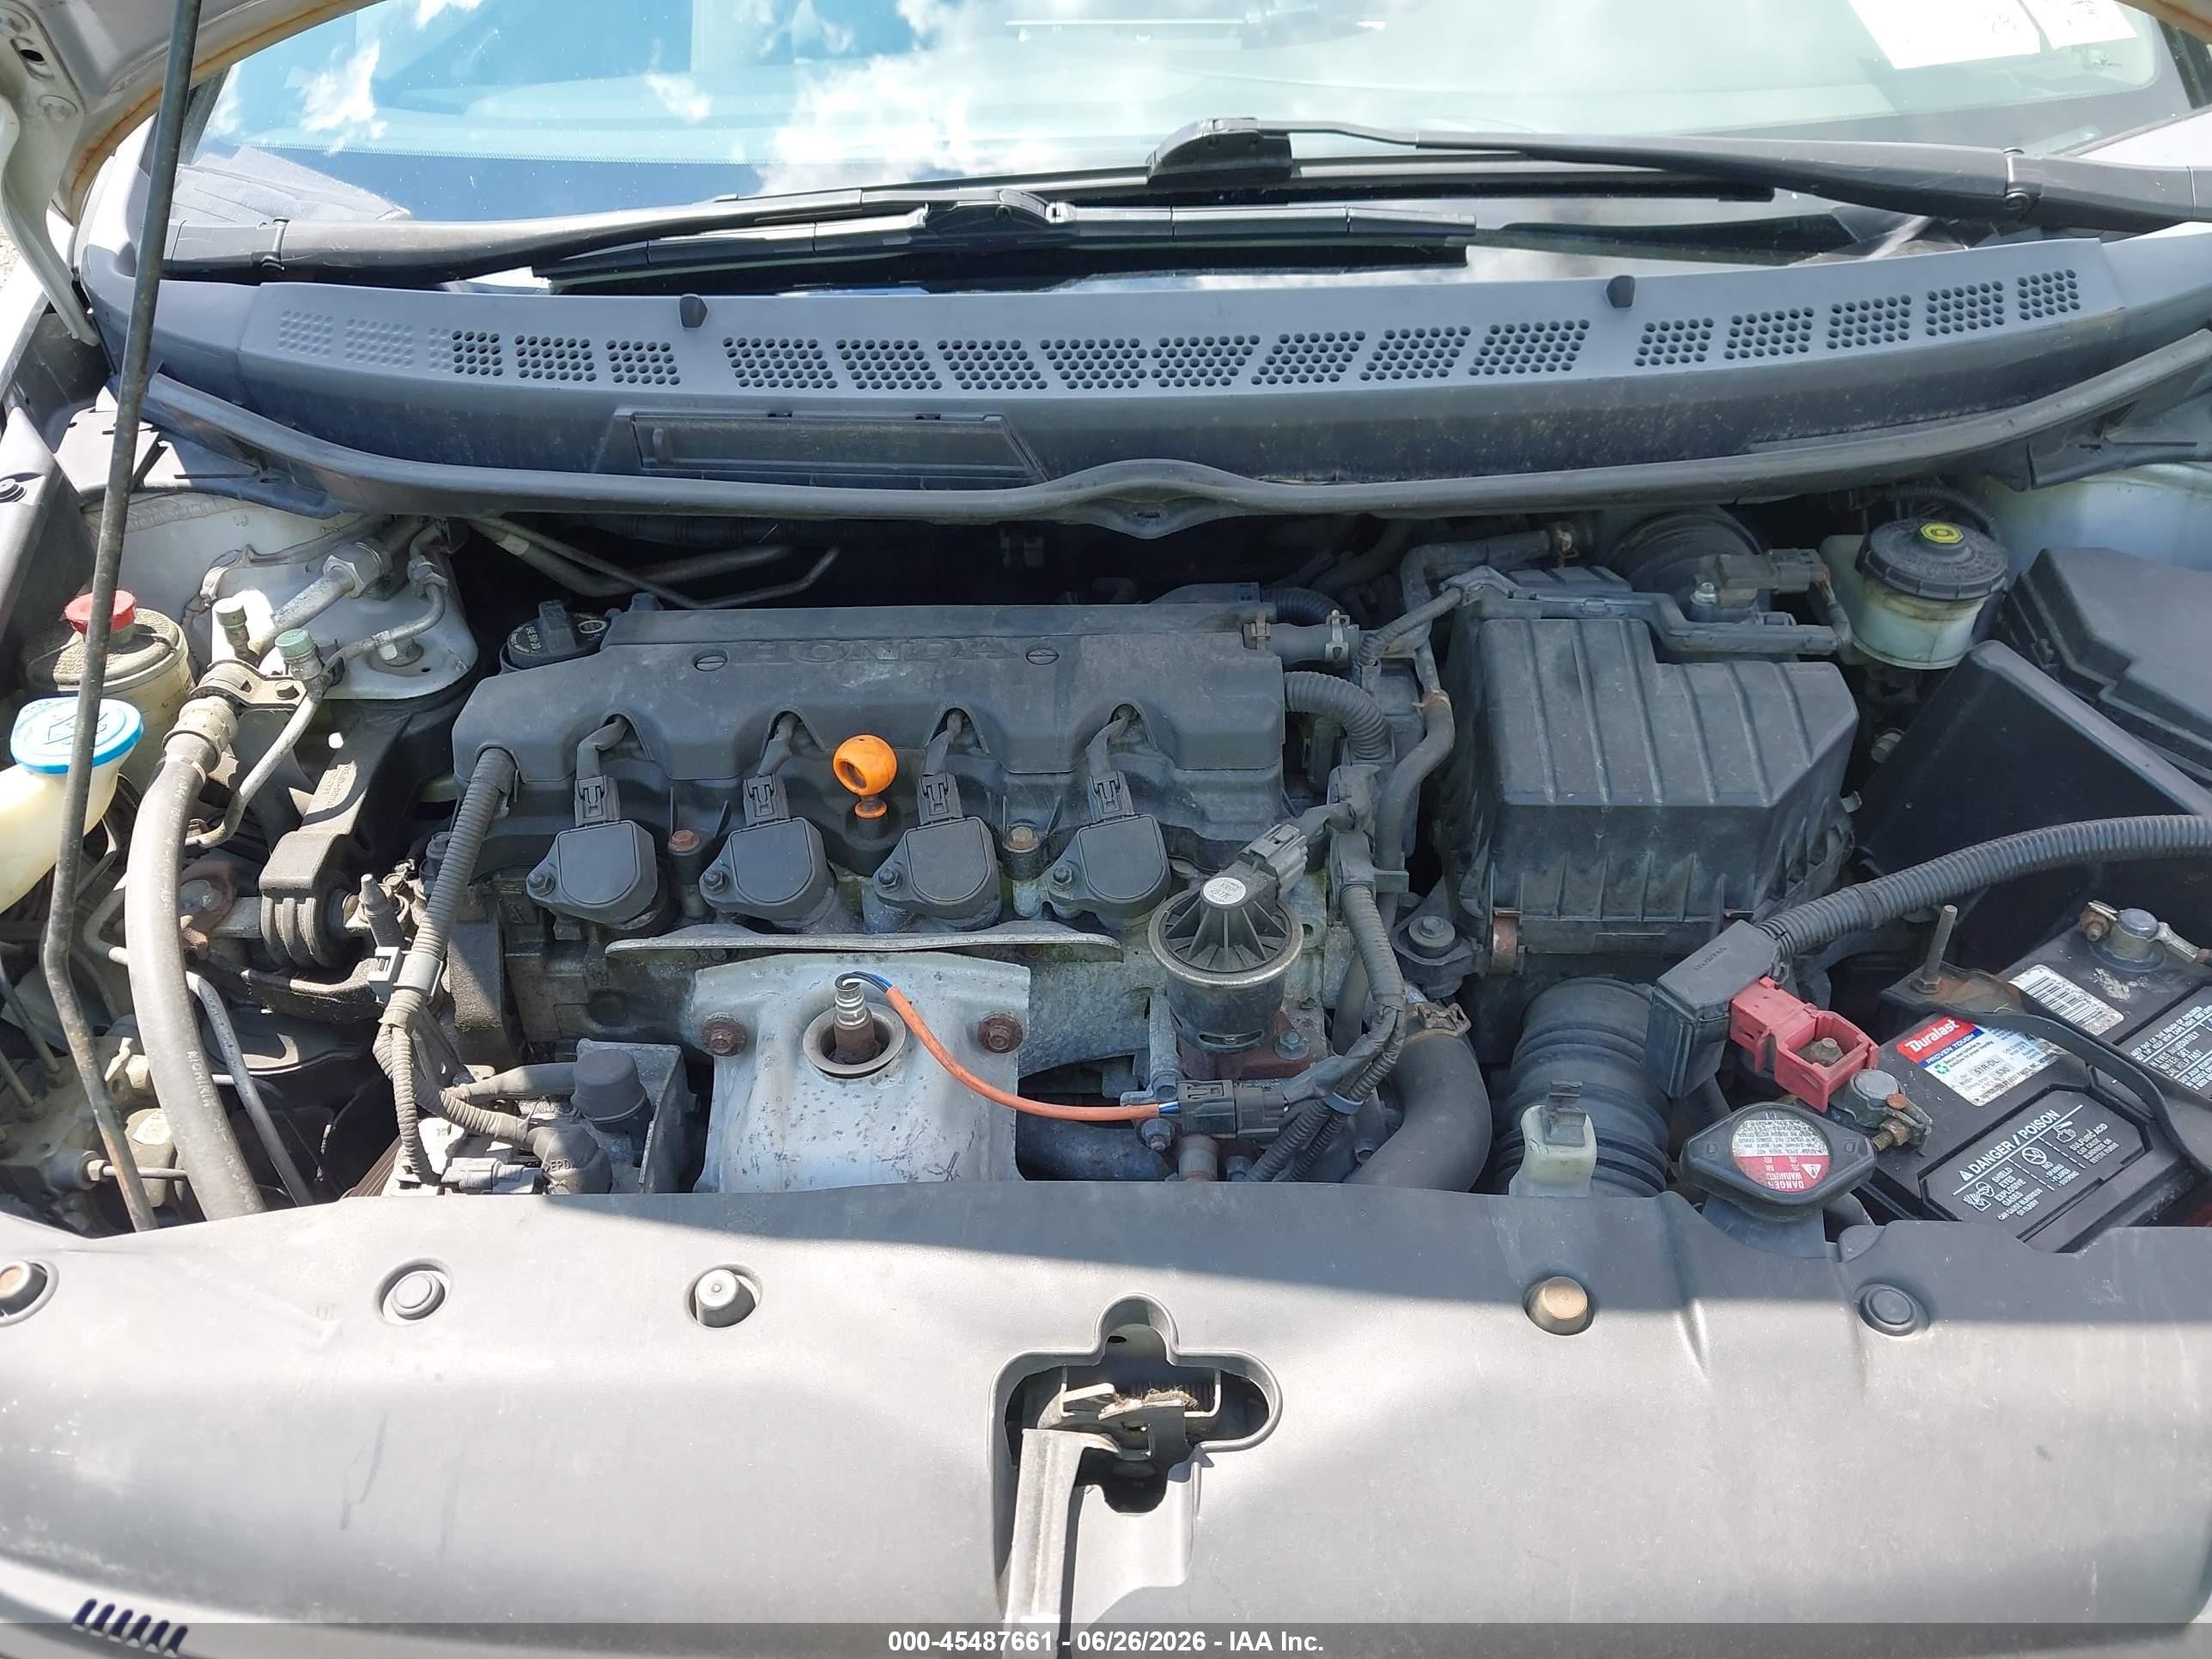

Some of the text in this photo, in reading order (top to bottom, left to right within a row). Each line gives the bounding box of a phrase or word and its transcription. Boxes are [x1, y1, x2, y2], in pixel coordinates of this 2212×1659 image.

[1905, 1019, 1960, 1053] Duralast
[1925, 1034, 1975, 1064] PROVEN TOUGH
[2188, 1049, 2203, 1060] FAST
[2156, 1053, 2170, 1062] EYES
[1973, 1059, 2000, 1075] 51R-DL
[1996, 1066, 2010, 1077] 530
[1968, 1141, 2016, 1174] DANGER
[2018, 1109, 2061, 1139] POISON
[1991, 1167, 2014, 1182] SHIELD
[1998, 1176, 2016, 1188] EYES
[1995, 1178, 2027, 1201] EXPLOSIVE
[2002, 1191, 2023, 1206] GASES
